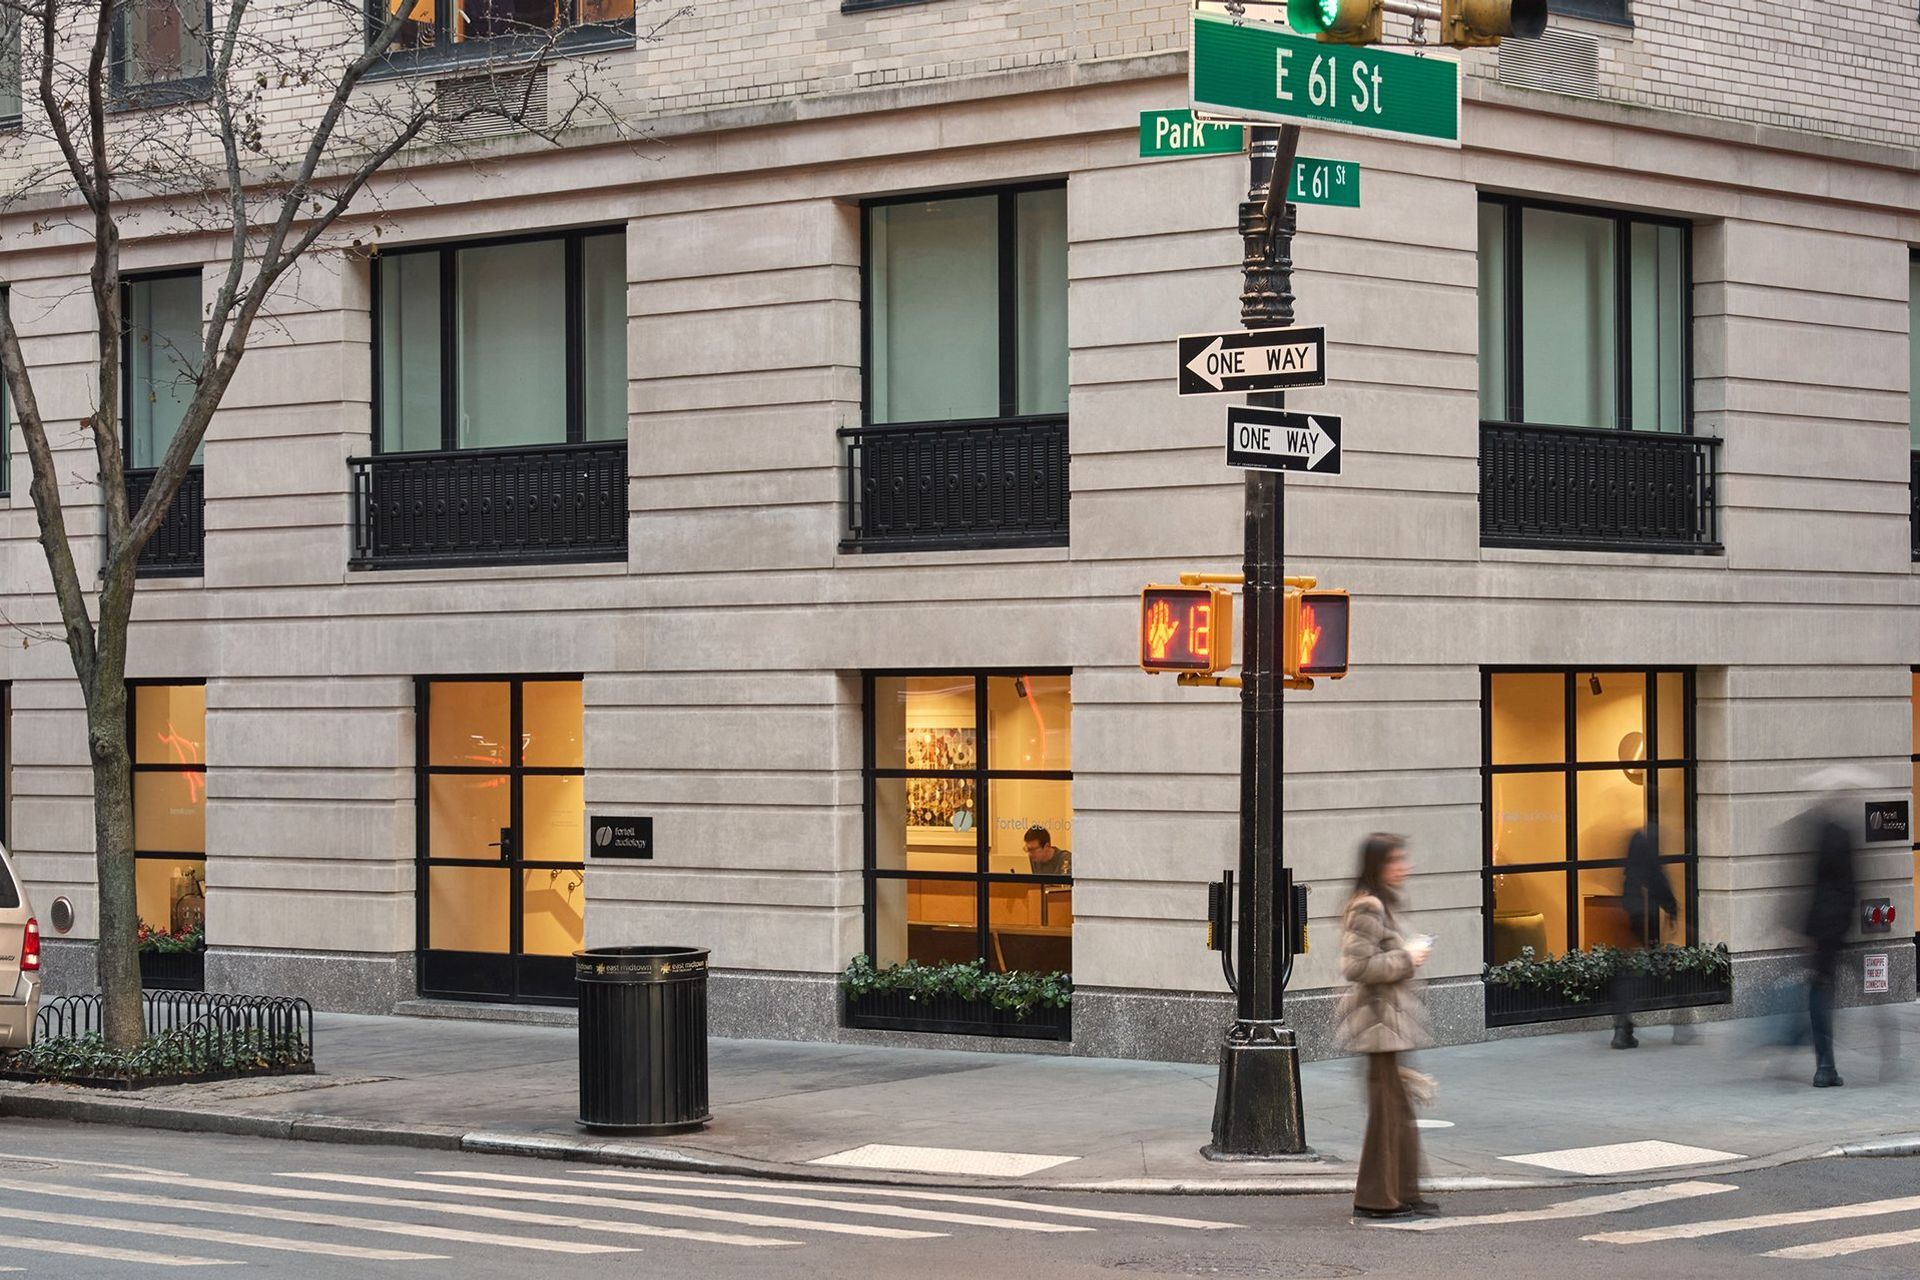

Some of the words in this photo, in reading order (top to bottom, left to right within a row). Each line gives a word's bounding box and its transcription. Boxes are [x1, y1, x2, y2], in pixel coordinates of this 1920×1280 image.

[1276, 47, 1293, 101] E
[1308, 54, 1336, 108] 61
[1351, 60, 1383, 114] St
[1156, 116, 1205, 149] Park
[1297, 163, 1306, 197] E
[1312, 165, 1329, 199] 61
[1335, 164, 1346, 185] St
[1207, 351, 1245, 375] ONE
[1266, 346, 1309, 371] WAY
[1240, 426, 1271, 451] ONE
[1287, 430, 1320, 454] WAY
[614, 827, 635, 837] fortell
[994, 817, 1029, 831] fortell
[1032, 817, 1072, 831] audiolo
[614, 838, 647, 849] audiology
